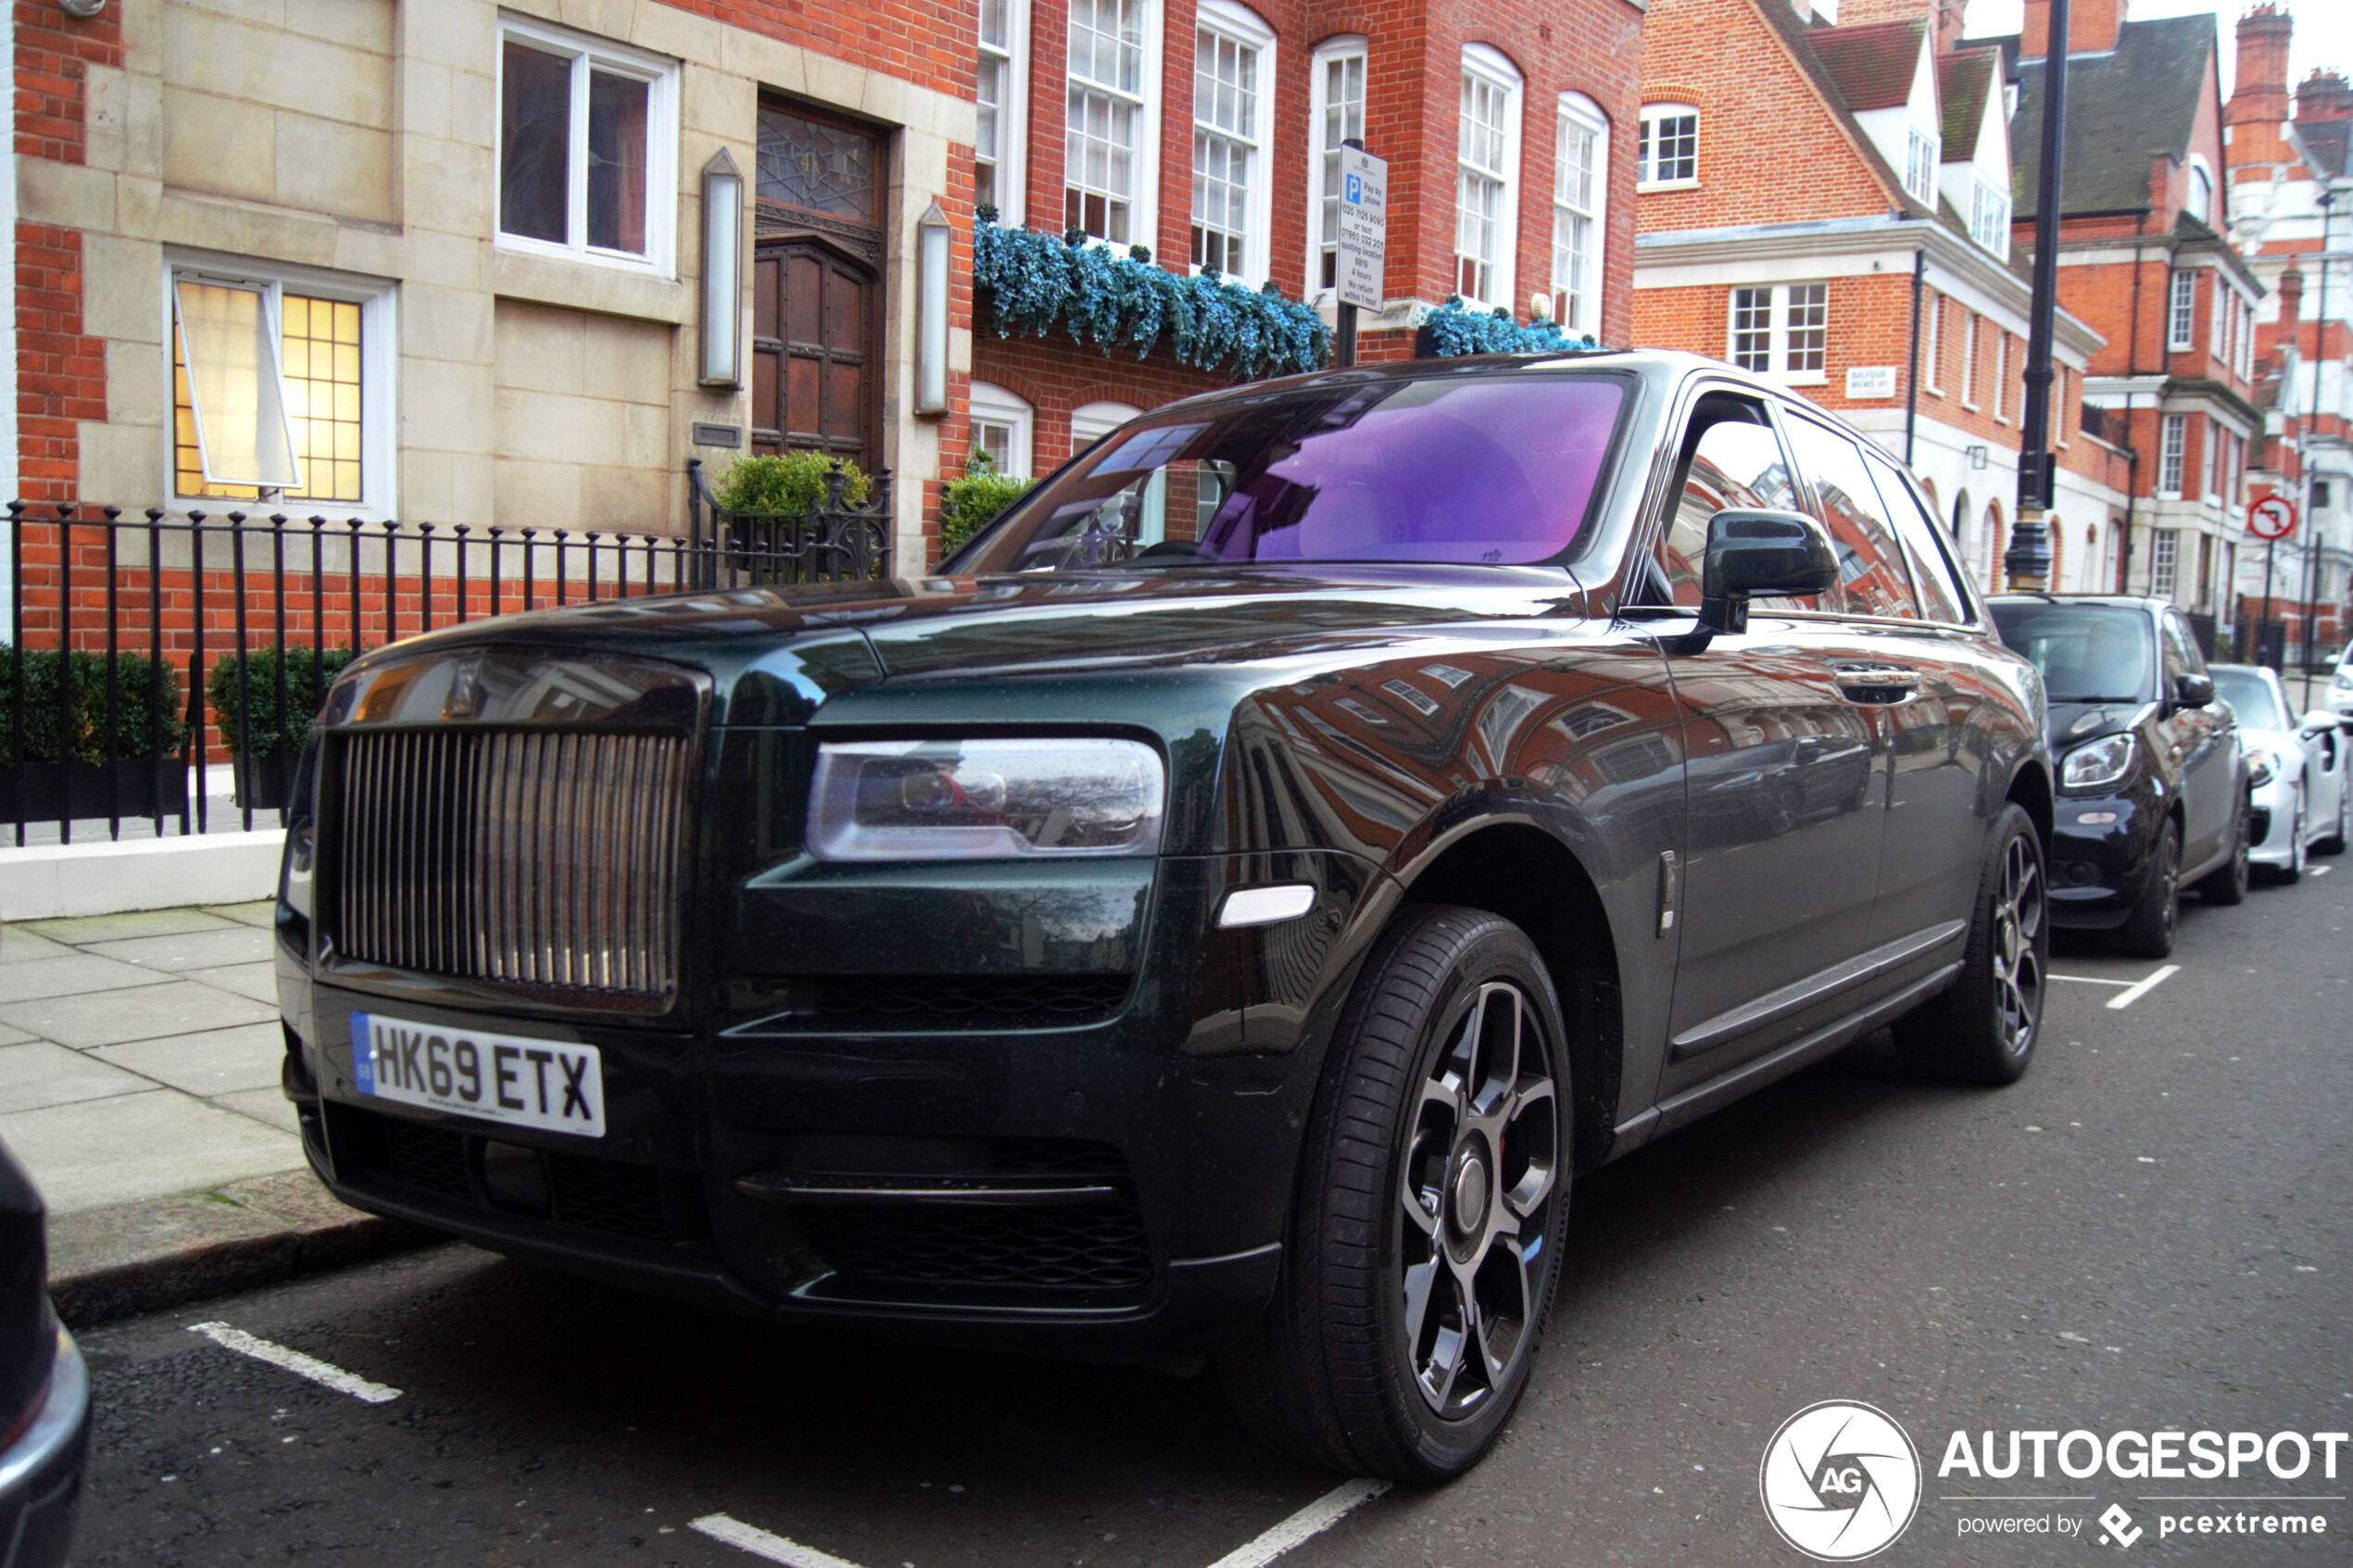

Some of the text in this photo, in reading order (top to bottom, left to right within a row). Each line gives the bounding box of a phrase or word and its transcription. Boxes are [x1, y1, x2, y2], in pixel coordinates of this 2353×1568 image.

[1365, 182, 1382, 197] Pay by
[1365, 195, 1380, 207] phone
[1342, 204, 1354, 216] 020
[1356, 209, 1368, 221] 7125
[1361, 224, 1372, 235] text
[1341, 227, 1384, 250] 07860 022 205
[1341, 241, 1383, 260] quoting location
[1352, 268, 1371, 281] 4 hours
[1349, 280, 1374, 295] No return
[1344, 290, 1360, 303] within
[1365, 296, 1378, 307] hour
[1852, 370, 1886, 379] BALFOUR
[1852, 380, 1875, 388] MEWS
[376, 1025, 593, 1121] HK69 ETX
